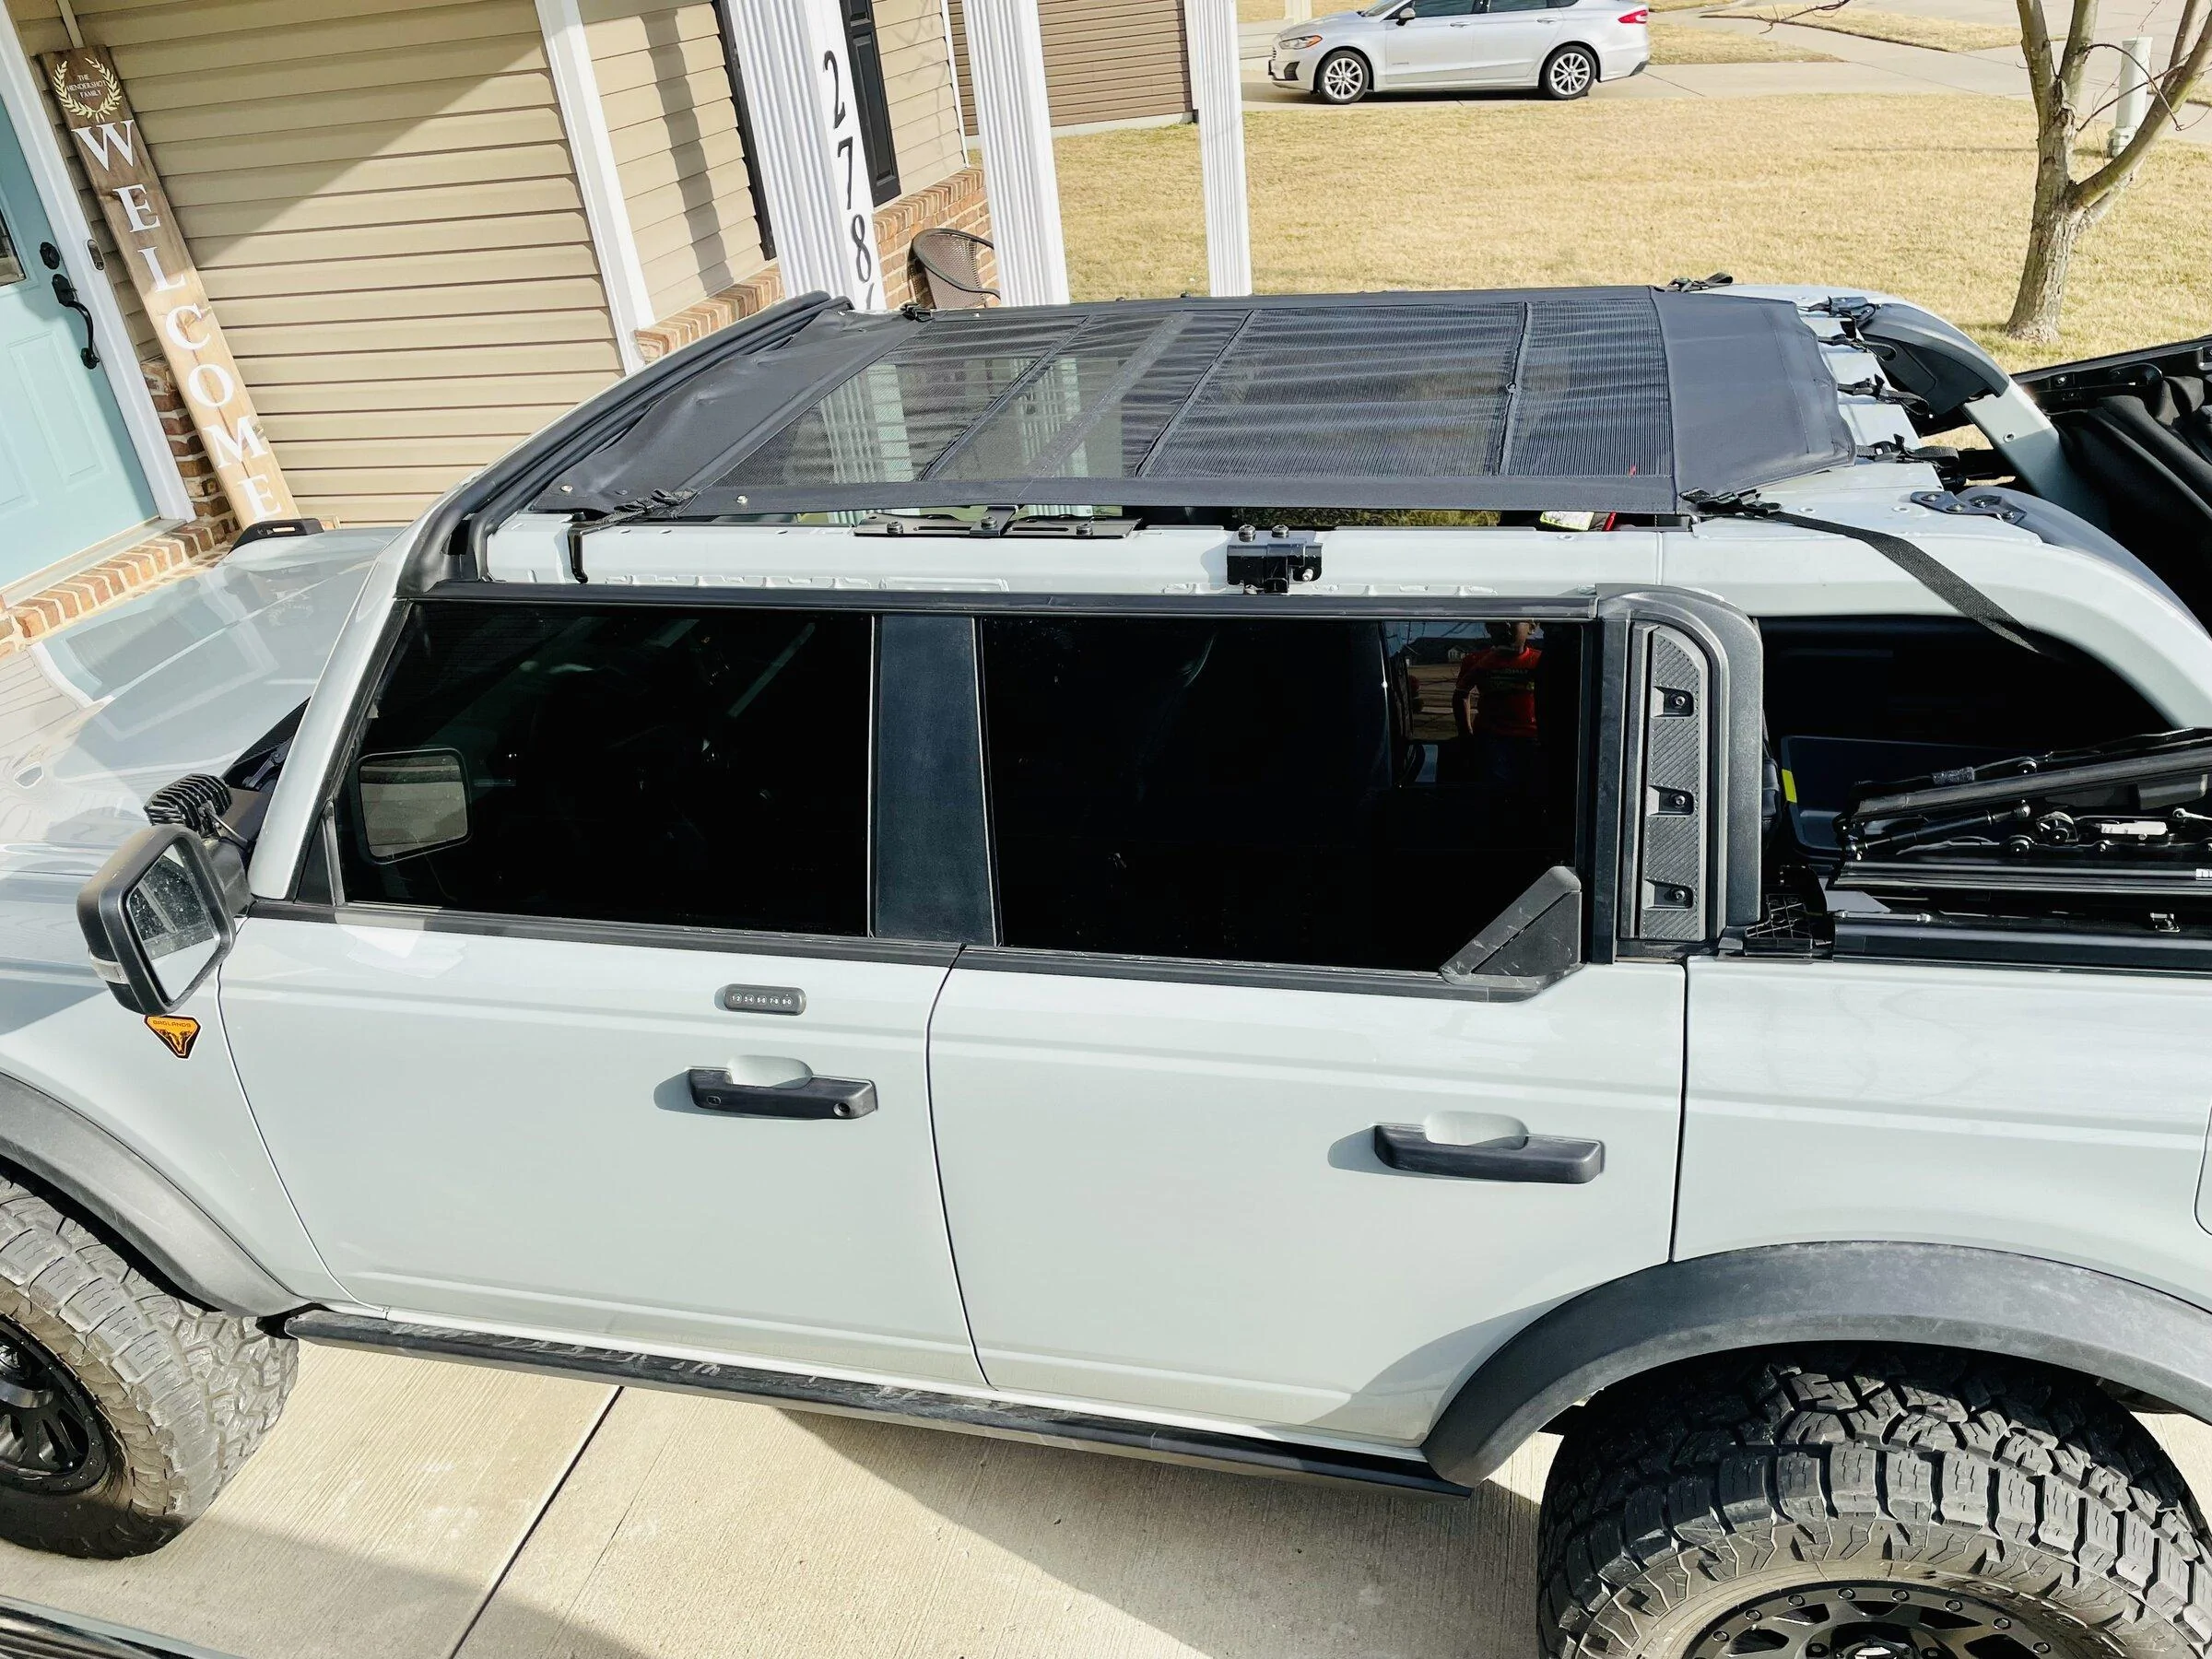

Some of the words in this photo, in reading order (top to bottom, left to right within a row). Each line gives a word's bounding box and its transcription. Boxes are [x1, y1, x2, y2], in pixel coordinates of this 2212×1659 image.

[66, 80, 107, 91] HENDERSHOT
[79, 89, 101, 99] FAMILY
[72, 119, 284, 521] WELCOME
